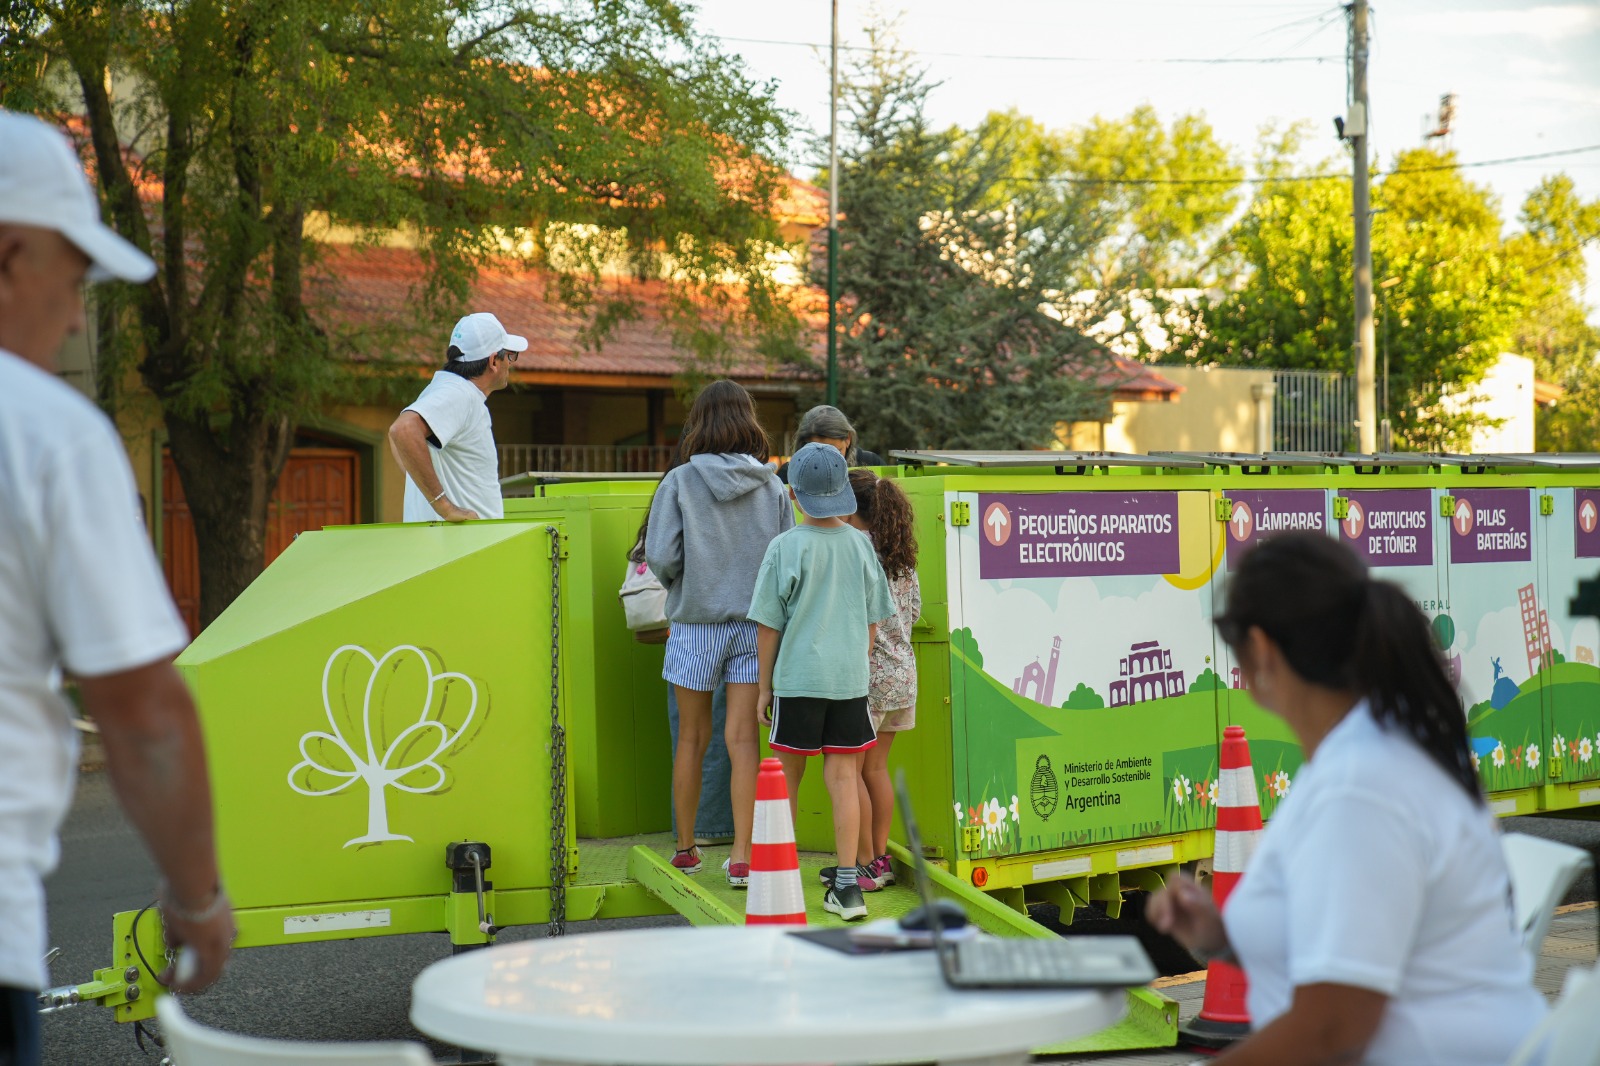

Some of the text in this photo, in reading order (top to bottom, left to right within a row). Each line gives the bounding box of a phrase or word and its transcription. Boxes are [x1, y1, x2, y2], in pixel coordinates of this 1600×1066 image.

[1019, 509, 1172, 537] PEQUEÑOS APARATOS
[1255, 506, 1323, 531] LÁMPARAS
[1368, 511, 1426, 529] CARTUCHOS
[1476, 509, 1506, 527] PILAS
[1019, 537, 1125, 563] ELECTRÓNICOS
[1368, 532, 1417, 554] DE TÓNER
[1477, 527, 1527, 551] BATERÍAS
[1415, 600, 1451, 611] NERAL
[1064, 756, 1152, 774] Ministerio de Ambiente
[1064, 769, 1151, 791] y Desarrollo Sostenible
[1065, 791, 1121, 812] Argentina
